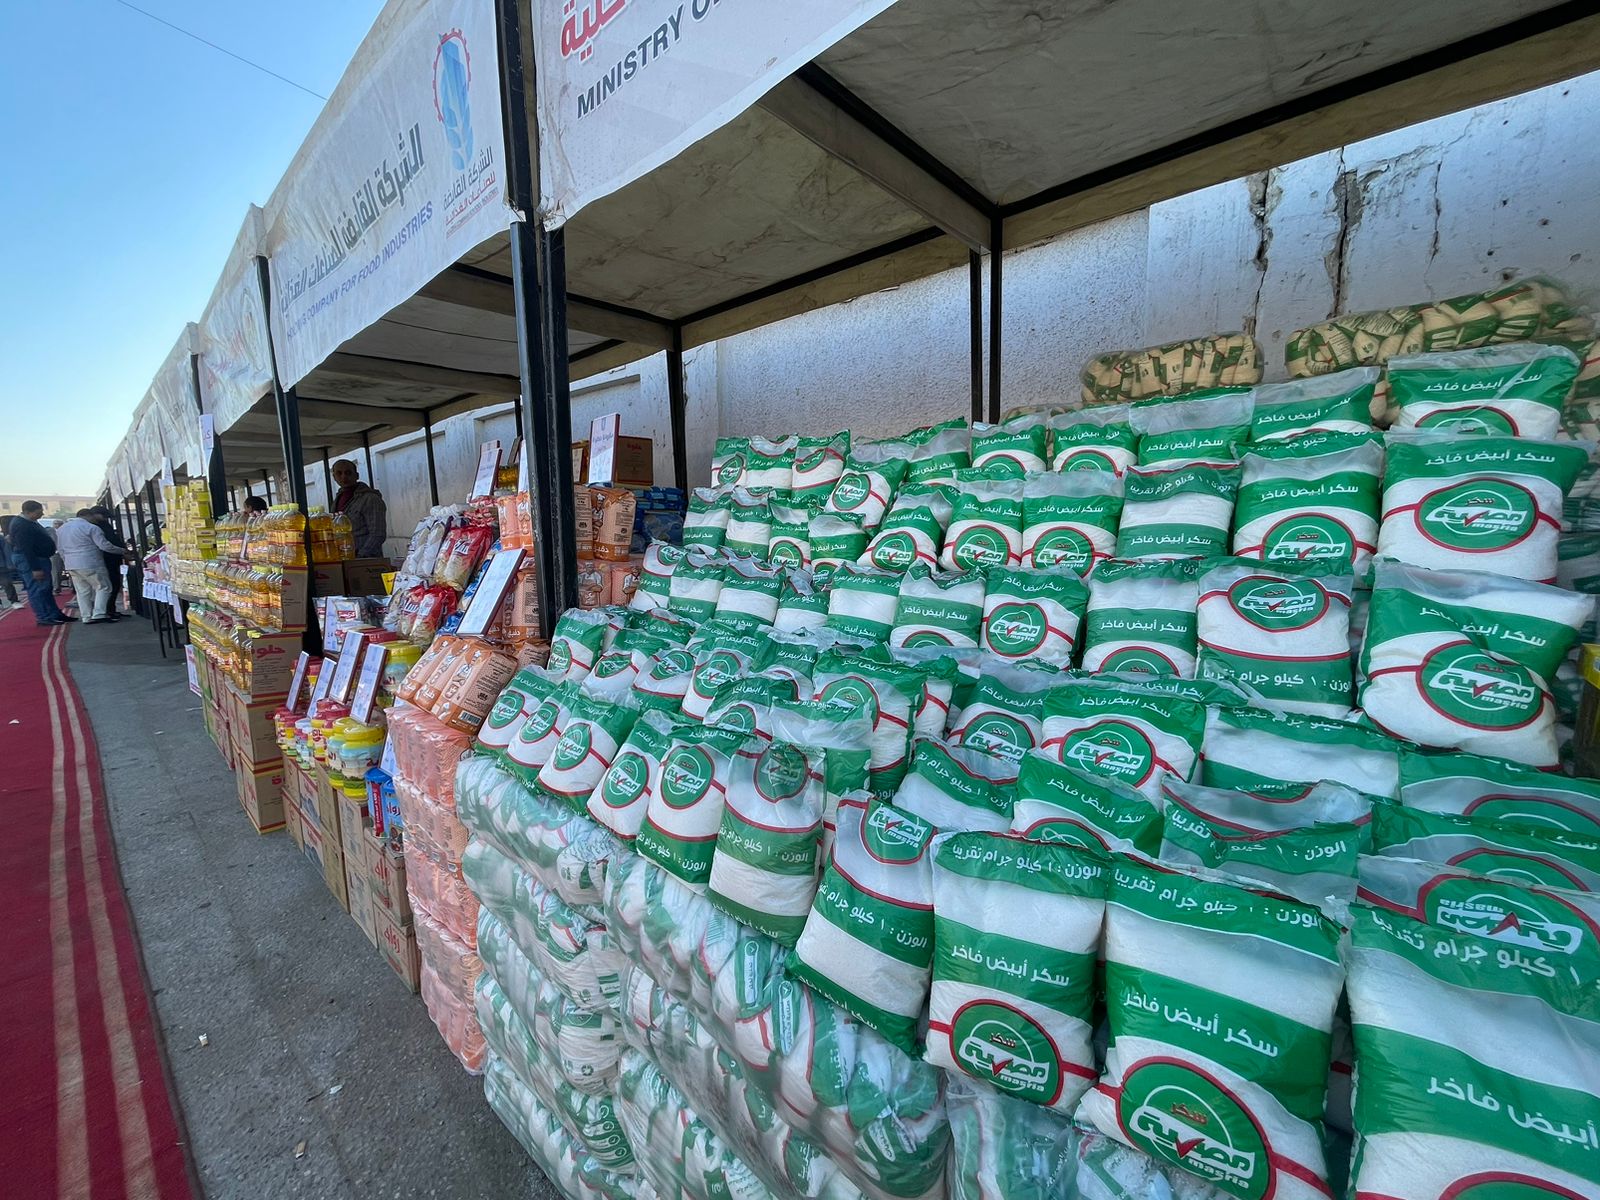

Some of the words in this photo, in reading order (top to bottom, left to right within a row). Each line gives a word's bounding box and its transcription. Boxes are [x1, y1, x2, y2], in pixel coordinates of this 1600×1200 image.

[577, 4, 684, 119] MINISTRY
[375, 122, 425, 208] الشركة
[338, 178, 380, 250] القابضة
[307, 288, 341, 322] COMPANY
[340, 274, 357, 297] FOR
[358, 255, 381, 283] FOOD
[382, 200, 434, 260] INDUSTRIES
[1425, 454, 1463, 467] فاخر
[1465, 449, 1511, 463] أبيض
[1514, 450, 1556, 464] سكر
[1261, 488, 1289, 502] فاخر
[1291, 484, 1325, 498] أبيض
[1327, 483, 1359, 496] سكر
[1428, 505, 1527, 525] مصرية
[1130, 534, 1154, 546] فاخر
[1156, 533, 1185, 546] أبيض
[1187, 534, 1211, 546] سكر
[904, 604, 922, 616] فاخر
[923, 607, 946, 621] أبيض
[945, 611, 967, 622] سكر
[1100, 619, 1124, 631] فاخر
[1125, 618, 1157, 631] أبيض
[1160, 620, 1188, 633] سكر
[1500, 629, 1547, 647] سكر
[1239, 672, 1270, 685] جرام
[1273, 673, 1305, 685] كيلو
[1429, 667, 1535, 704] مصرية
[1141, 701, 1171, 718] سكر
[1480, 693, 1530, 710] masria
[1066, 741, 1146, 770] مصرية
[927, 760, 950, 778] جرام
[1100, 762, 1137, 776] masria
[950, 777, 973, 793] كيلو
[1047, 776, 1080, 797] فاخر
[1082, 792, 1114, 818] أبيض
[1115, 809, 1147, 825] سكر
[1171, 808, 1212, 838] تقريبا
[744, 838, 763, 853] كيلو
[952, 844, 982, 860] تقريبا
[983, 850, 1012, 866] جرام
[1016, 856, 1042, 872] كيلو
[1114, 868, 1157, 893] تقريبا
[826, 890, 850, 912] جرام
[1158, 887, 1199, 909] جرام
[849, 905, 876, 925] كيلو
[1371, 910, 1425, 950] تقريبا
[951, 944, 984, 964] فاخر
[1433, 938, 1488, 965] جرام
[986, 955, 1028, 977] أبيض
[1496, 948, 1556, 978] كيلو
[1030, 967, 1070, 987] سكر
[1122, 991, 1160, 1013] فاخر
[1164, 1005, 1220, 1035] أبيض
[1224, 1026, 1279, 1058] سكر
[958, 1036, 1050, 1084] مصرية
[1000, 1074, 1045, 1093] masria
[1426, 1076, 1500, 1112] فاخر
[1507, 1104, 1600, 1151] أبيض
[1129, 1104, 1256, 1180] مصرية
[1187, 1156, 1250, 1190] masria
